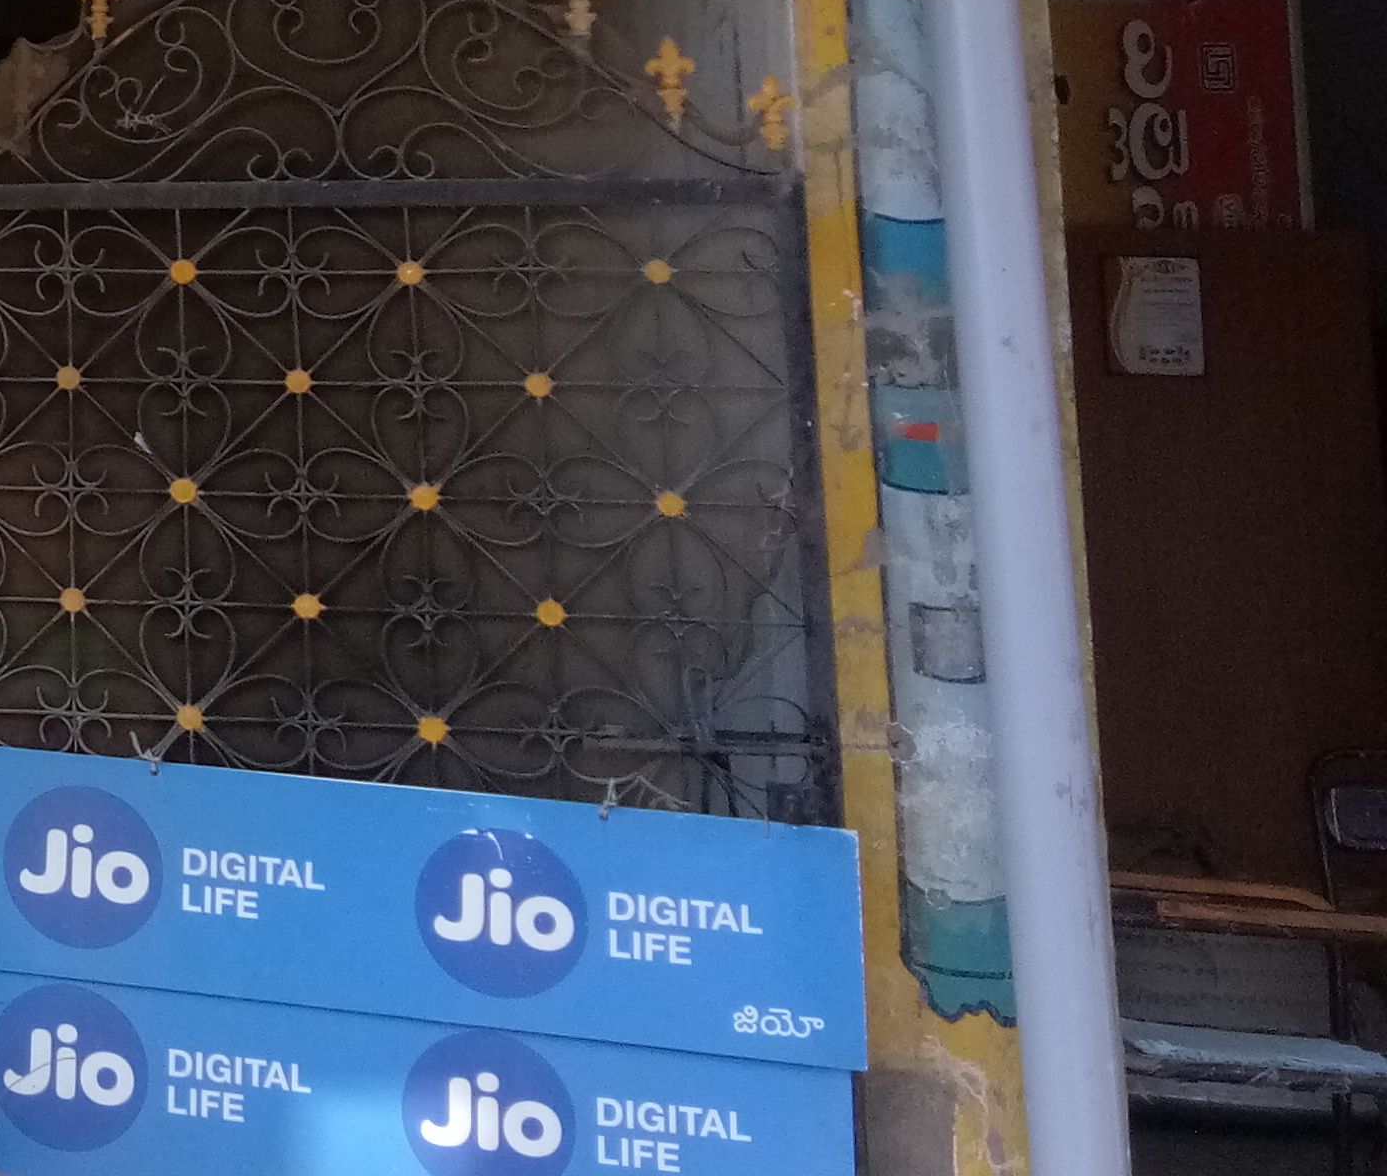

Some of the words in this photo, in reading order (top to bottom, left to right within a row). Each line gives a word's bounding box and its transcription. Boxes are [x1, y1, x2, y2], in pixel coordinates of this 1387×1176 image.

[19, 824, 150, 905] Jio
[182, 847, 326, 891] DIGITAL
[181, 883, 259, 920] LIFE
[433, 868, 575, 952] Jio
[608, 891, 764, 936] DIGITAL
[608, 929, 693, 966] LIFE
[732, 1004, 825, 1039] జియో
[3, 1023, 135, 1107] Jio
[167, 1048, 313, 1095] DIGITAL
[167, 1085, 245, 1123] LIFE
[420, 1071, 563, 1158] Jio
[596, 1096, 753, 1143] DIGITAL
[596, 1134, 681, 1173] LIFE
